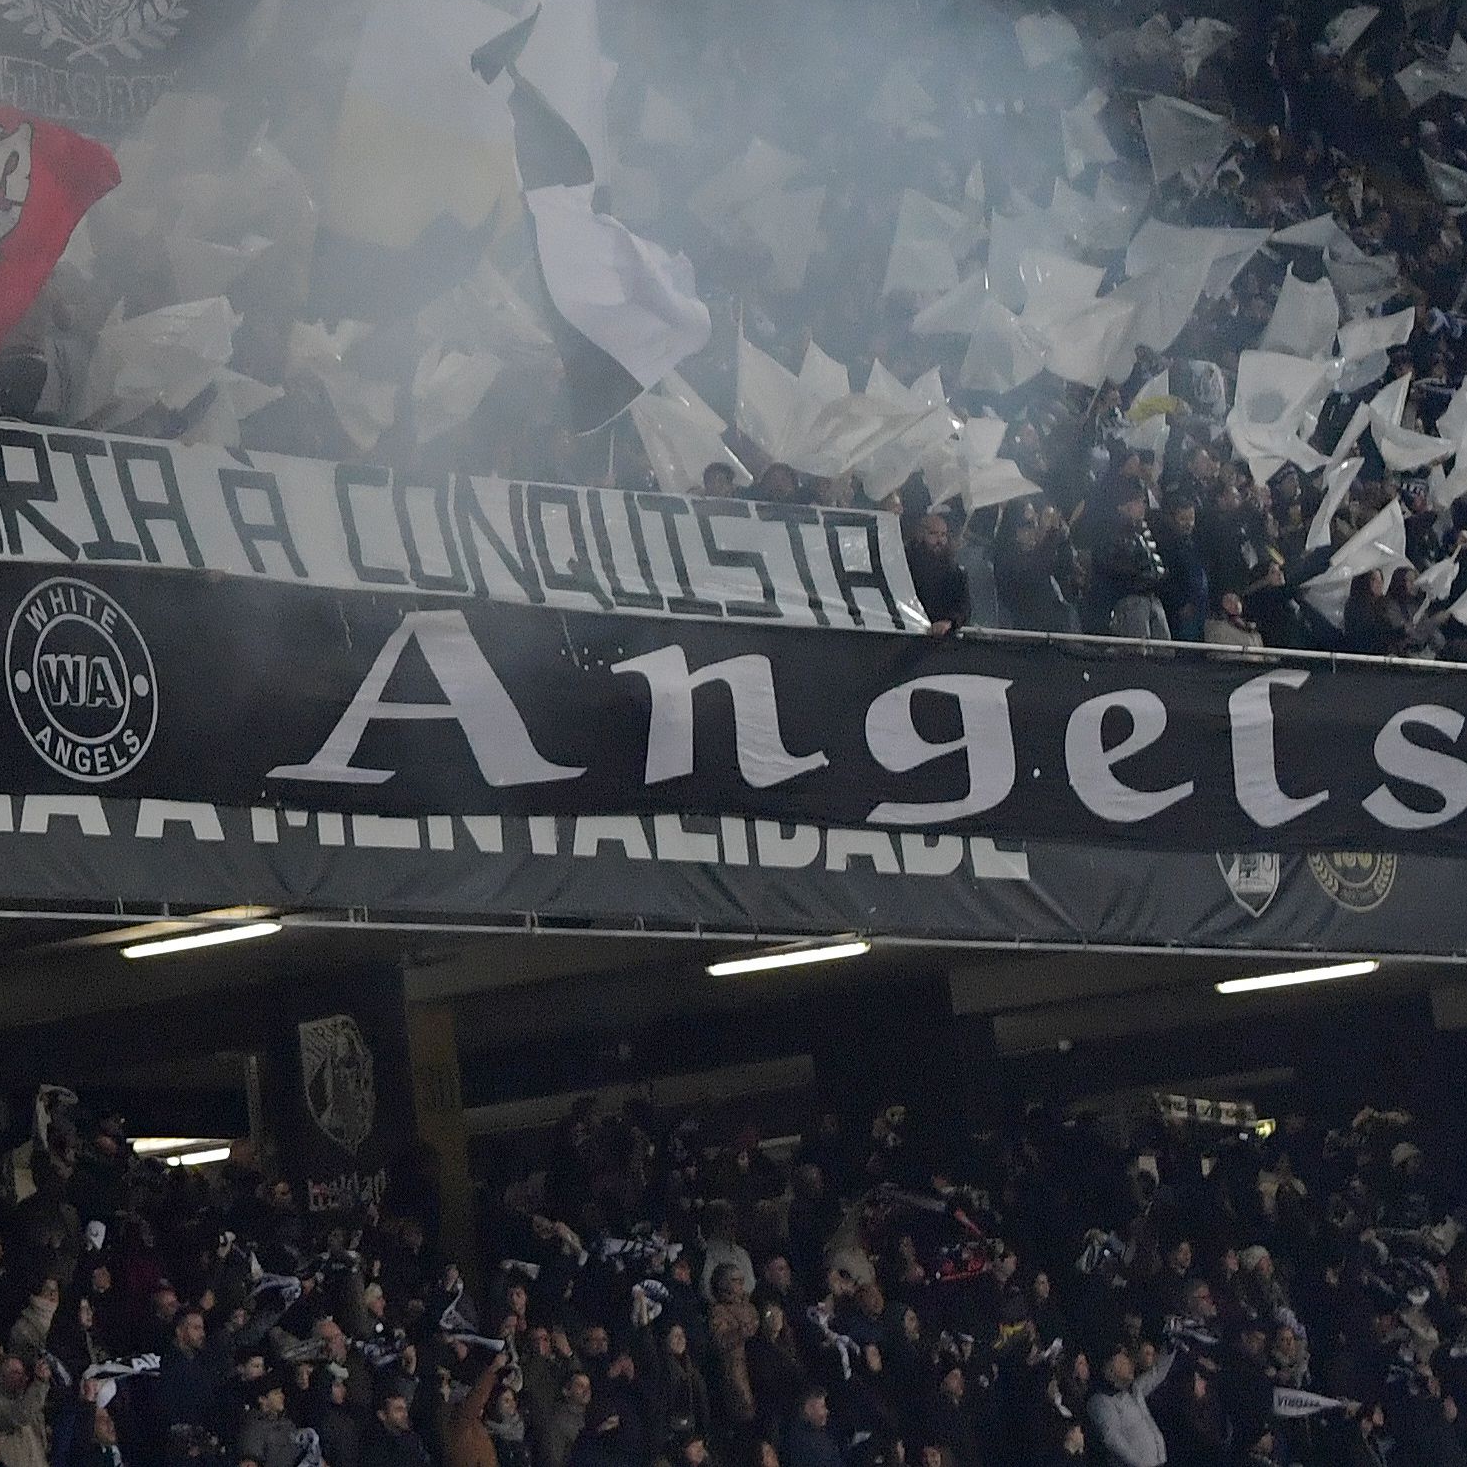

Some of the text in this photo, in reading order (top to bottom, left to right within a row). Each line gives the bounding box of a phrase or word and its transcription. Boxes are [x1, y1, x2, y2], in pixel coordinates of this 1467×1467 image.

[334, 465, 908, 630] CONQUISTA
[25, 586, 119, 635] WHITE
[40, 653, 125, 710] WA
[265, 607, 1467, 832] Angels
[35, 725, 142, 774] ANGELS
